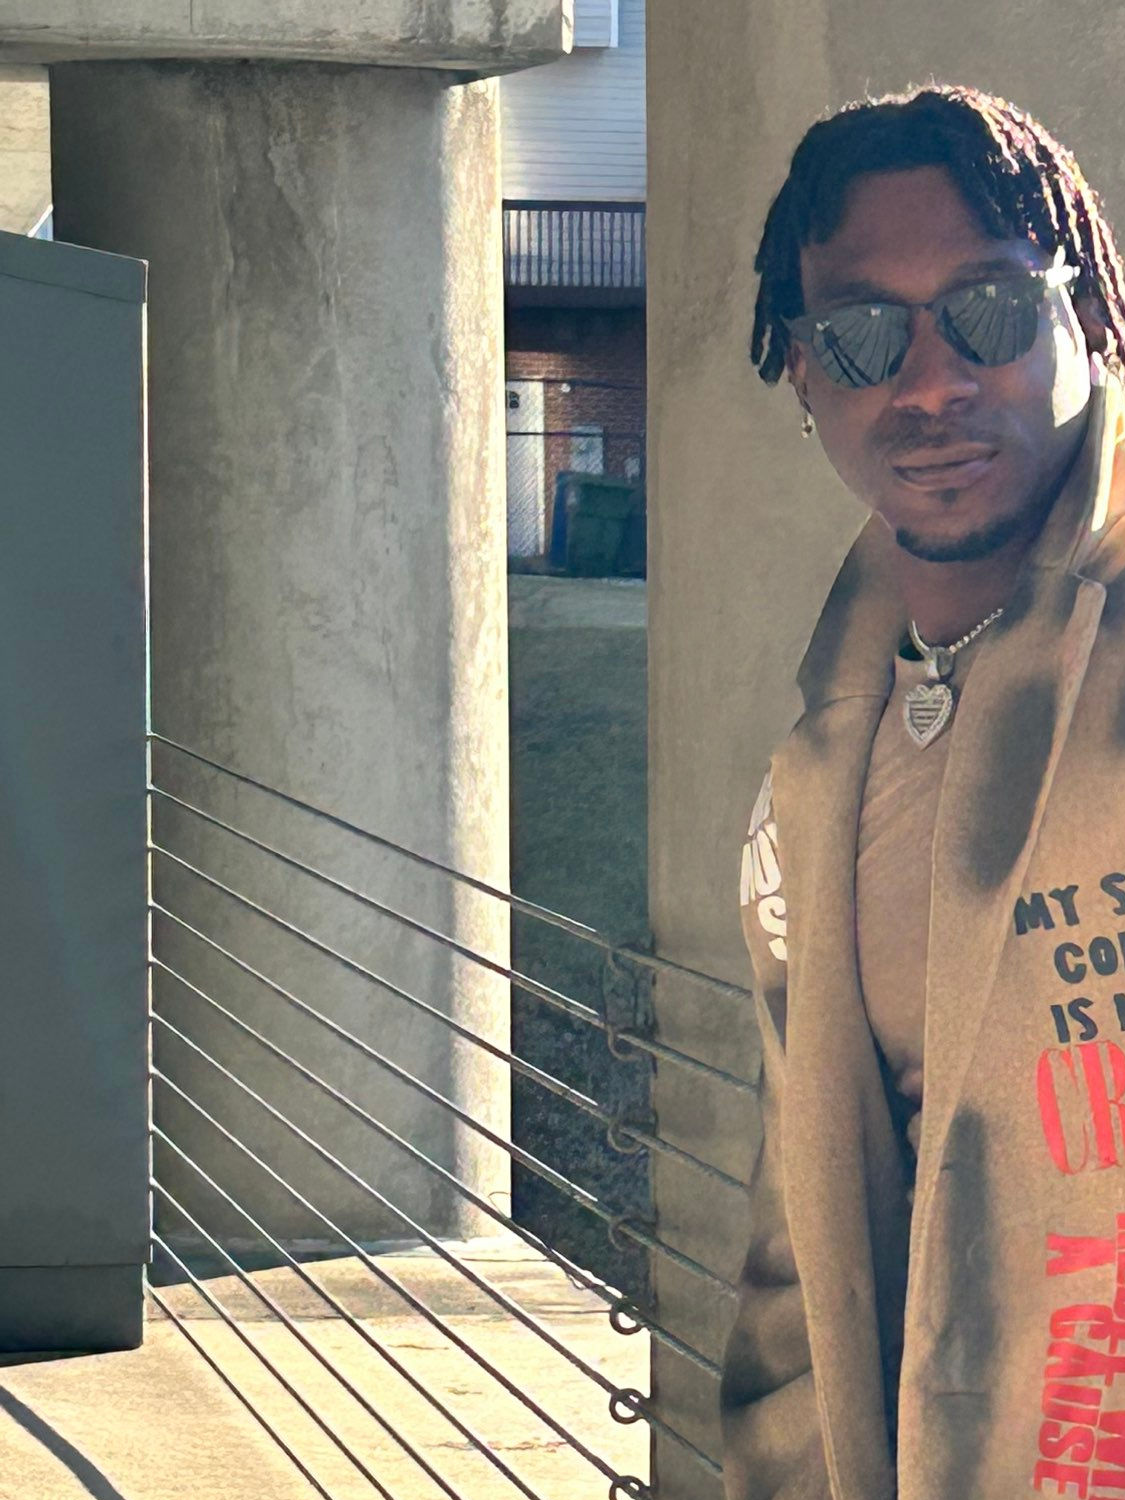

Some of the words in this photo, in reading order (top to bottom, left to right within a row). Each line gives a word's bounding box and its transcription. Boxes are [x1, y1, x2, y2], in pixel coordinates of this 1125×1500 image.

[1013, 884, 1080, 935] MY
[1050, 997, 1098, 1043] IS
[1045, 1232, 1116, 1277] A
[1033, 1304, 1114, 1500] CAUSE
